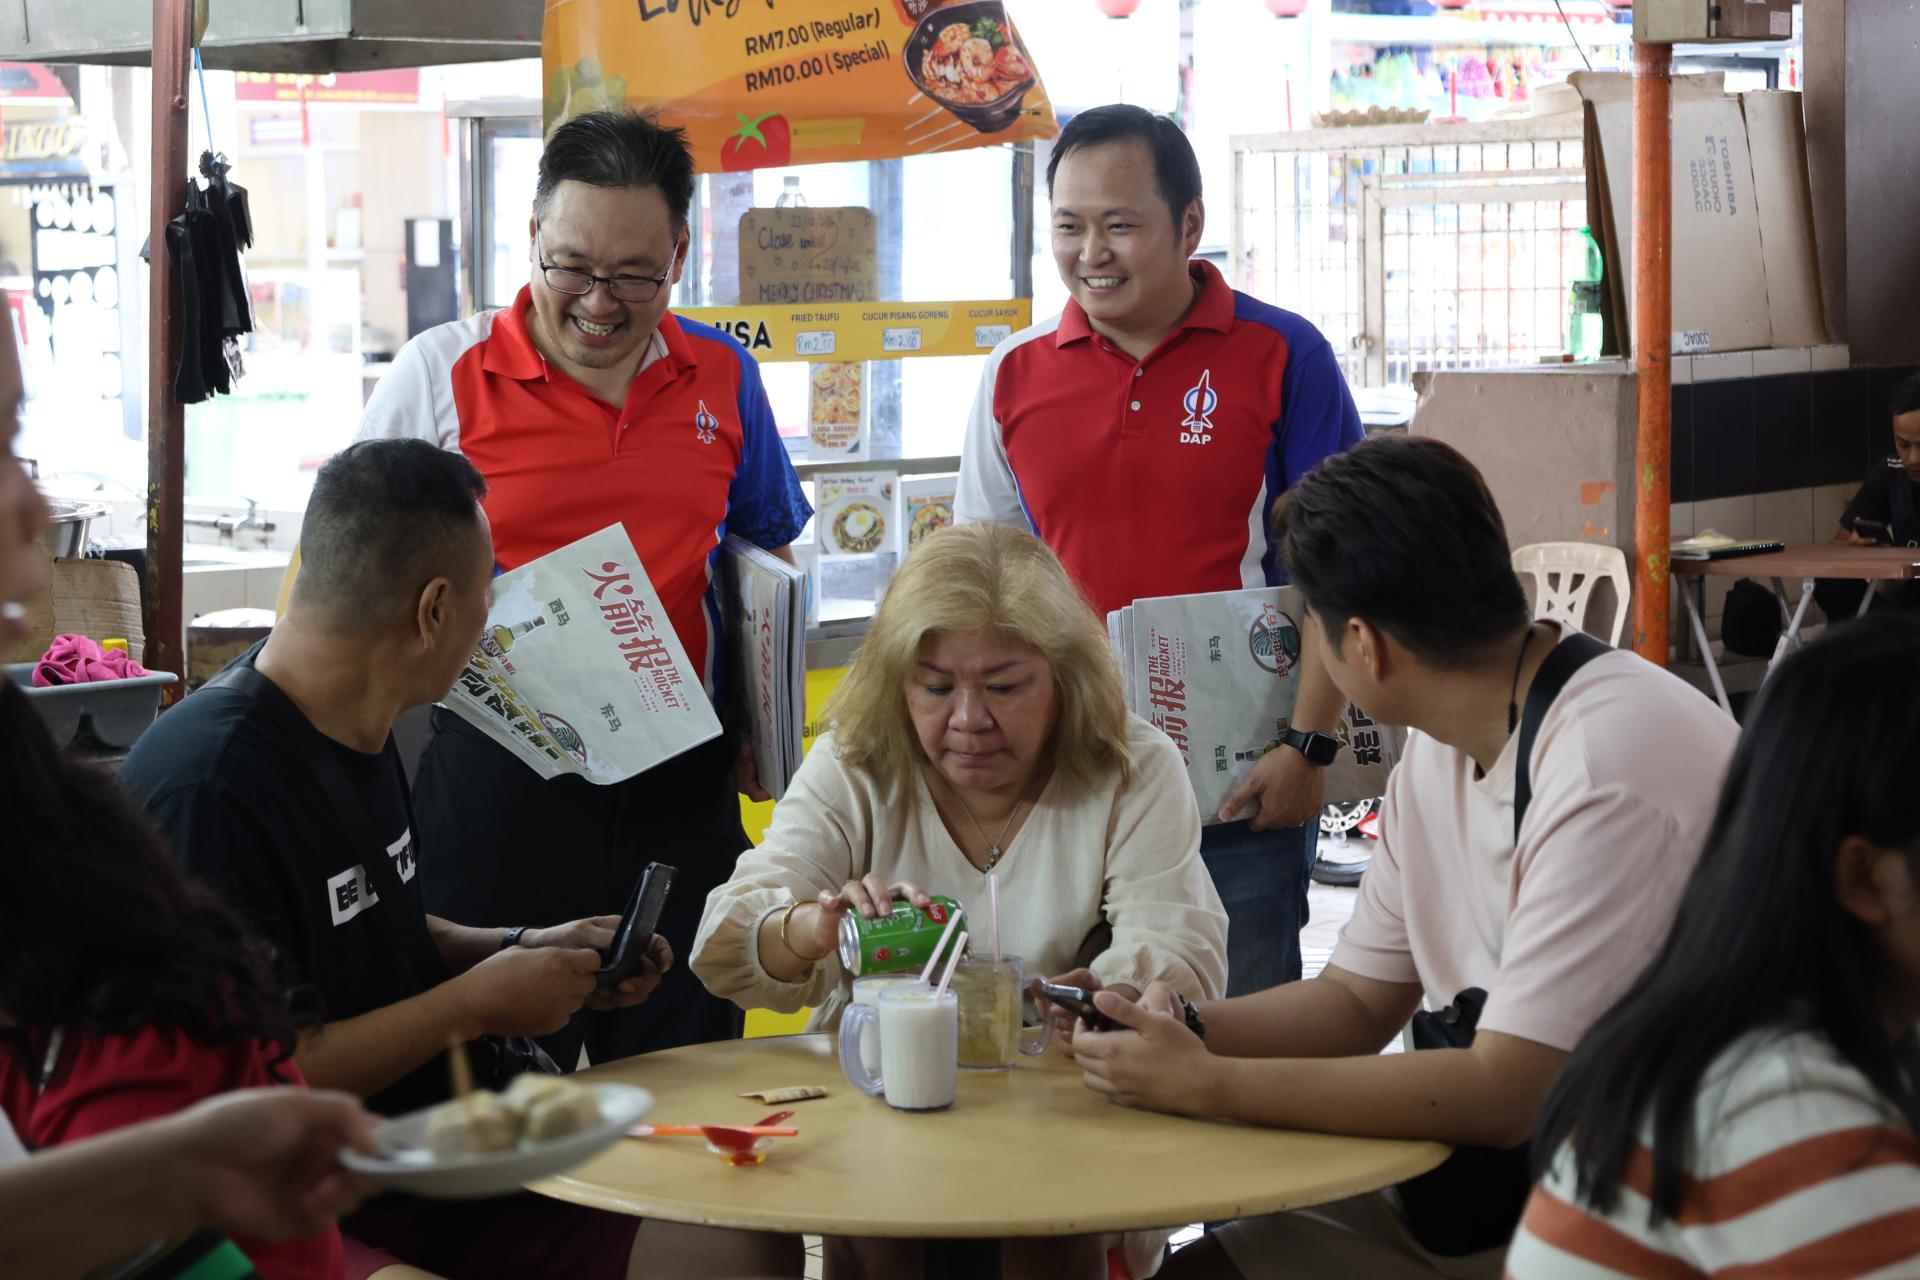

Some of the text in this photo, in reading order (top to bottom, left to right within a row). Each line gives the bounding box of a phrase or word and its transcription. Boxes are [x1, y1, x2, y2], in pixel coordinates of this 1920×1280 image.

[745, 25, 809, 56] RM7.00
[810, 8, 881, 42] (Regular)
[745, 57, 823, 92] RM10.00
[1720, 136, 1736, 216] TOSHIBA
[758, 227, 794, 250] Close
[791, 312, 839, 322] FRIED TAUFU
[862, 310, 949, 321] CUCUR PISANG GORENG
[969, 309, 1018, 318] CUCUR SAYUR
[1180, 432, 1212, 445] DAP
[548, 598, 570, 627] 西马
[580, 561, 673, 673] 火箭报
[1158, 634, 1170, 677] ROCKET
[1208, 635, 1222, 663] 东马
[664, 665, 683, 686] THE
[1148, 654, 1158, 673] THE
[650, 669, 680, 709] ROCKET
[600, 702, 622, 732] 东马
[1214, 745, 1228, 772] 西马
